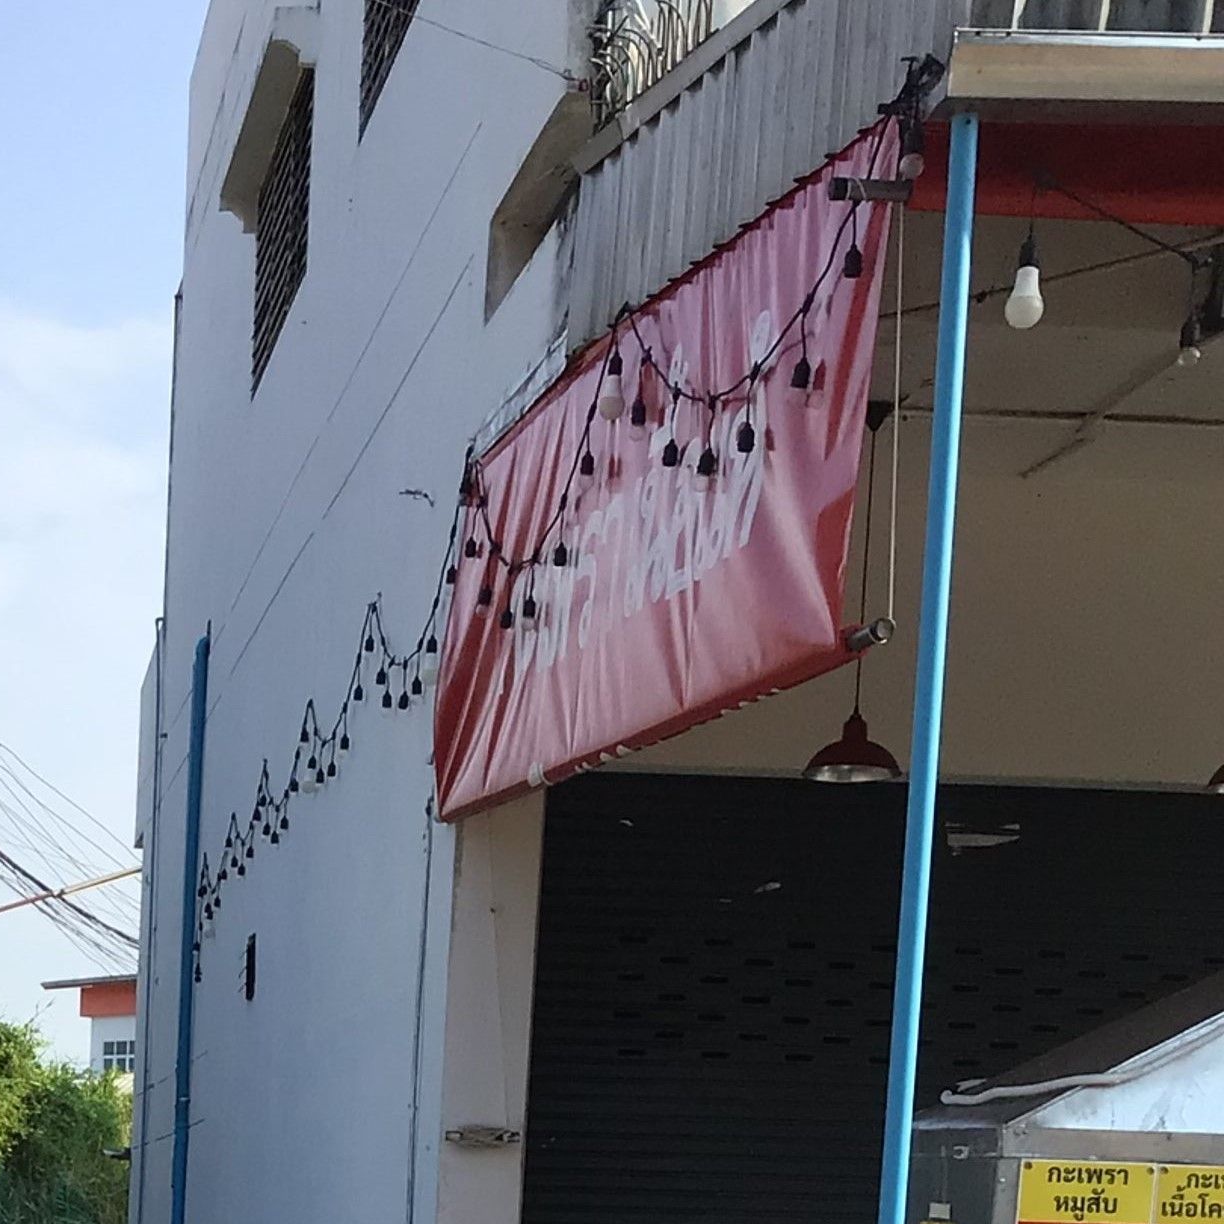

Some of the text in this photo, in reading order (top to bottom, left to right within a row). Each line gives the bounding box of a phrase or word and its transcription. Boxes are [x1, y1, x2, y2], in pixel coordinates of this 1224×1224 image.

[1047, 1166, 1129, 1186] กะเพรา
[1187, 1173, 1224, 1189] กะเ
[1054, 1188, 1118, 1222] หมูสับ
[1161, 1185, 1224, 1219] เนื้อโค
